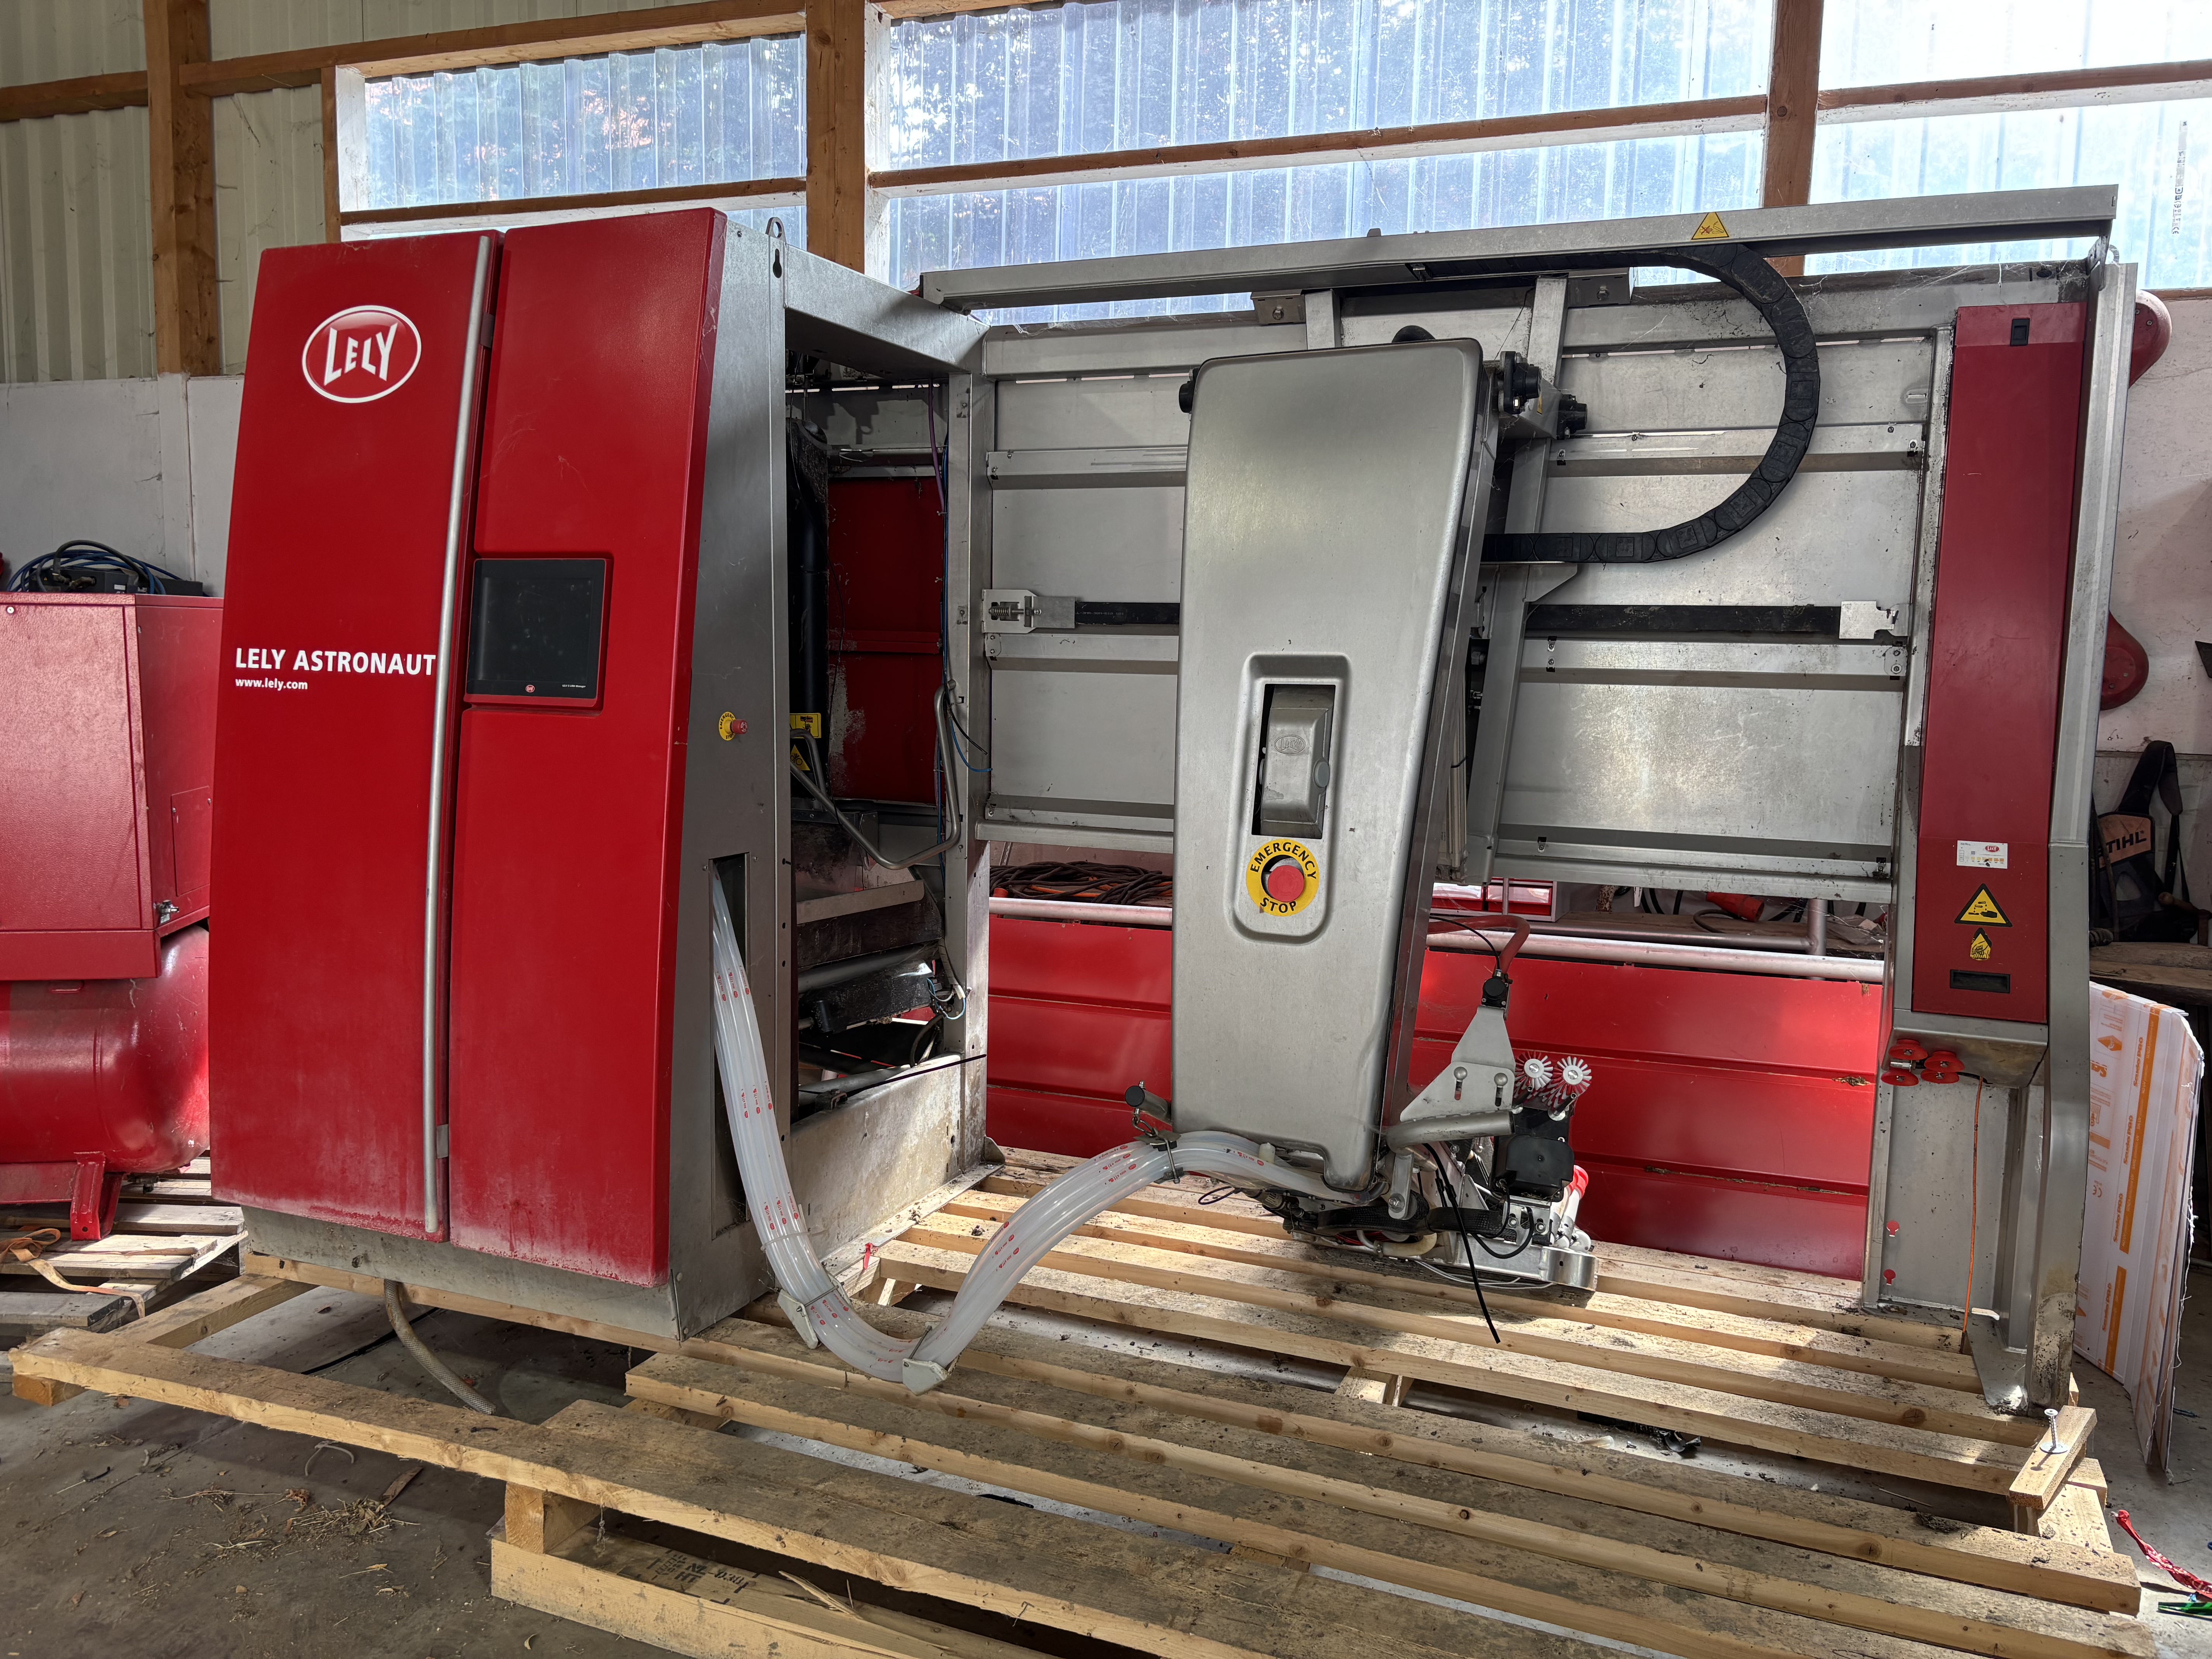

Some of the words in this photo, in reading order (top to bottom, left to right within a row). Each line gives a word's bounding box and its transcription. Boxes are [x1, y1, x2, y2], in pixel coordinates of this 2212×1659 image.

[324, 322, 398, 386] LELY
[236, 648, 286, 670] LELY
[293, 650, 436, 675] ASTRONAUT
[235, 678, 308, 691] www.lely.com
[720, 713, 734, 729] EMERGENC
[1281, 738, 1299, 750] LELY
[2099, 831, 2147, 854] TIHL
[1250, 842, 1316, 879] EMERGENCY
[1260, 897, 1297, 913] STOP
